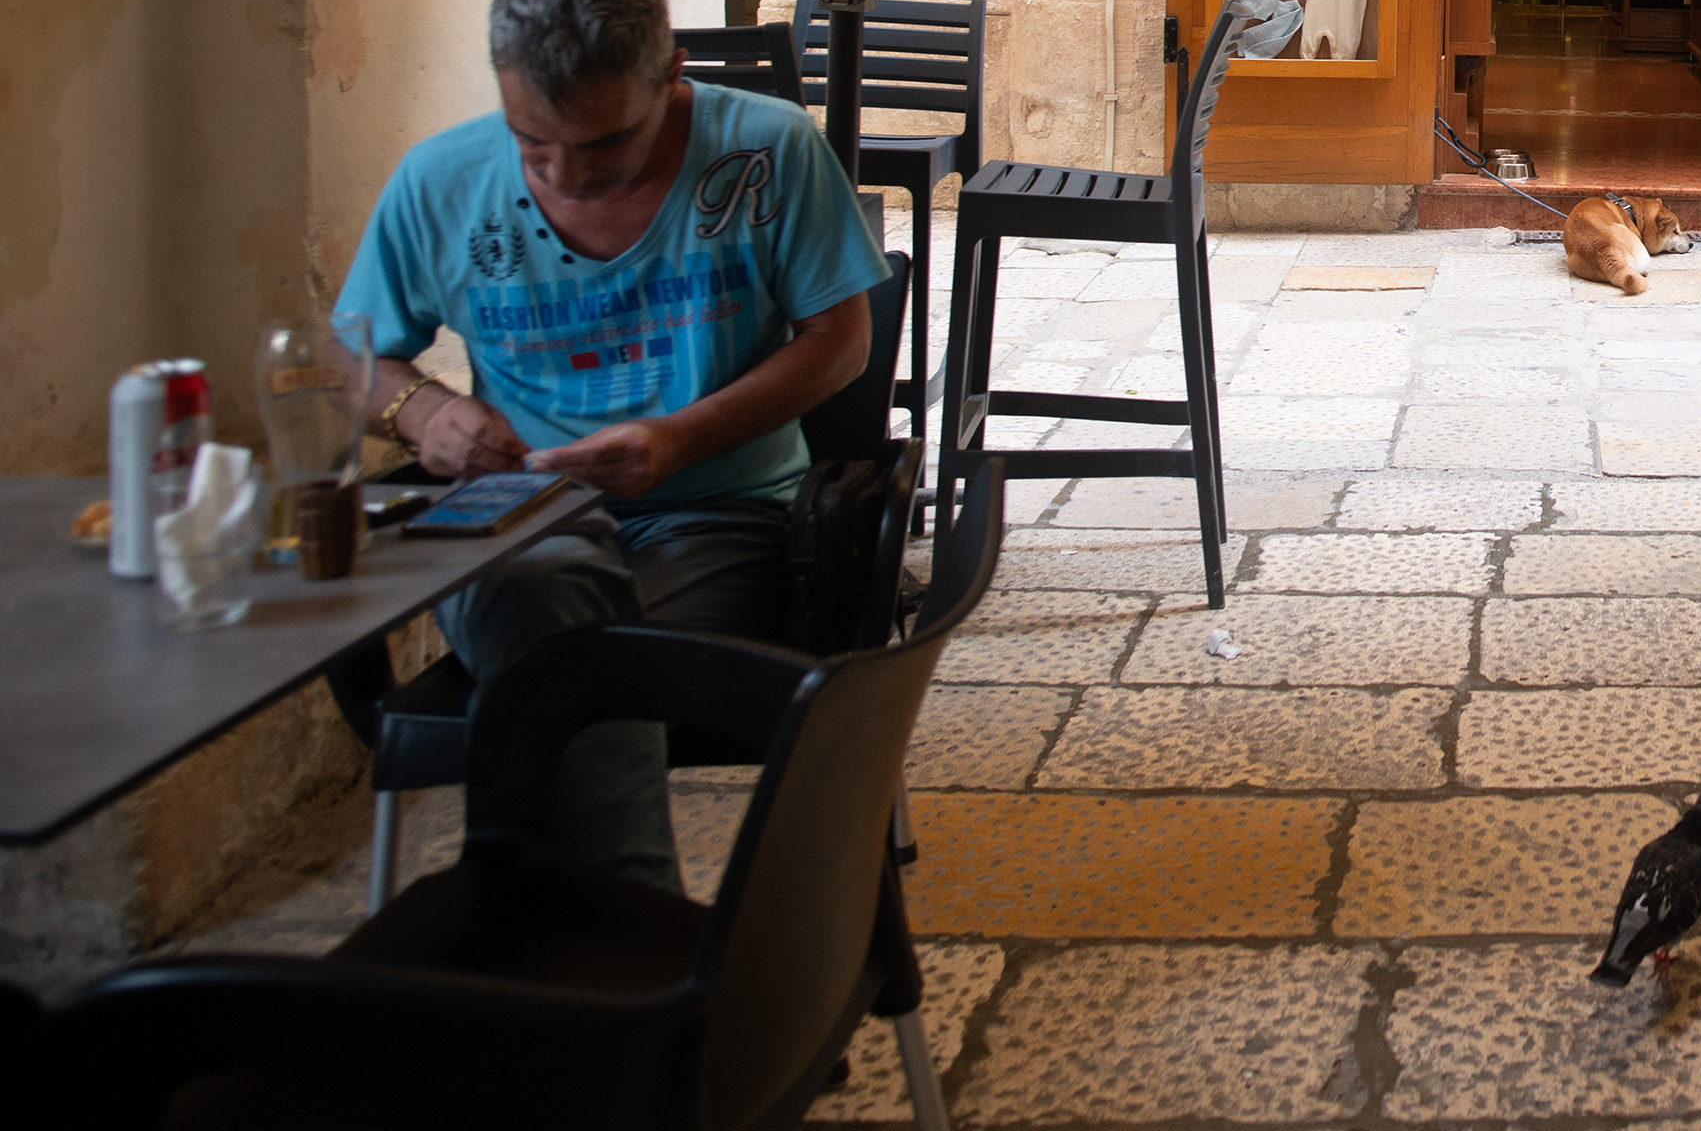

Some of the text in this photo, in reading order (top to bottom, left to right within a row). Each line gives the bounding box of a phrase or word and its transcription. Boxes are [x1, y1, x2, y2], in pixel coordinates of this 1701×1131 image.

[478, 262, 751, 331] FASHION WEAR NEW YORK
